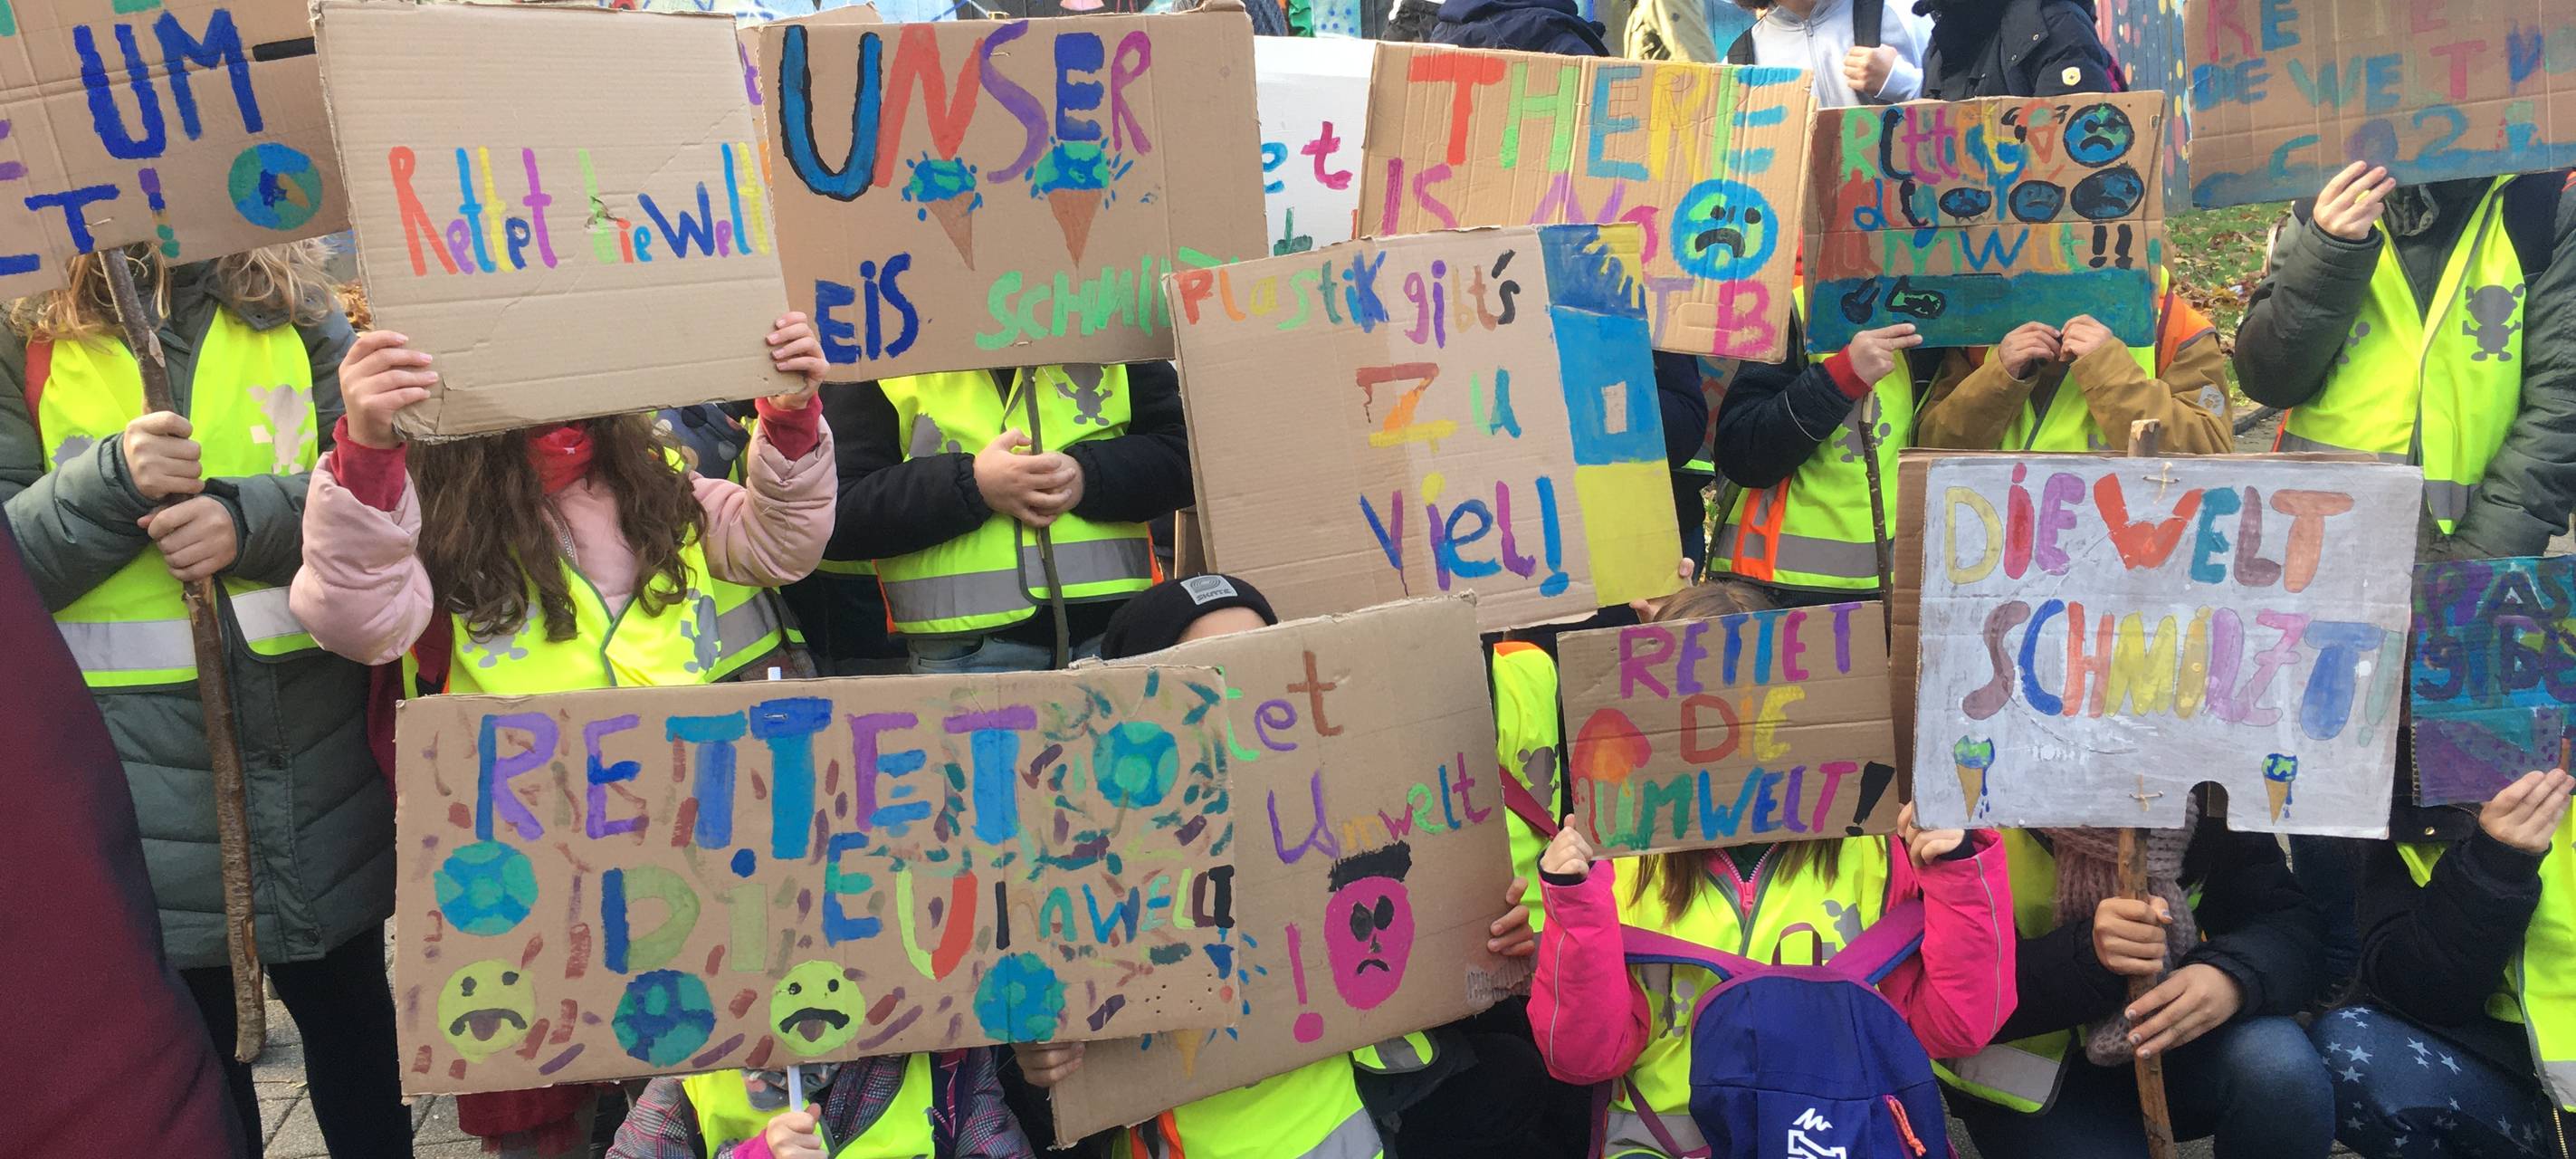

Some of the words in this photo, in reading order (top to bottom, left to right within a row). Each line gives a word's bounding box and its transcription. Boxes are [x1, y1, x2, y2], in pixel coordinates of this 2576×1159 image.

[778, 20, 1151, 202] UNSER
[1407, 52, 1801, 182] THERE
[388, 145, 558, 276] Rettet
[1382, 157, 1459, 236] IS
[1712, 279, 1777, 357] B
[2093, 472, 2355, 594] WELT
[1195, 589, 1232, 602] SKATE
[1618, 601, 1863, 700] RETTET
[475, 696, 1038, 861] RETTET
[1267, 751, 1493, 865] Umwelt
[1594, 760, 1895, 851] UMWELT!
